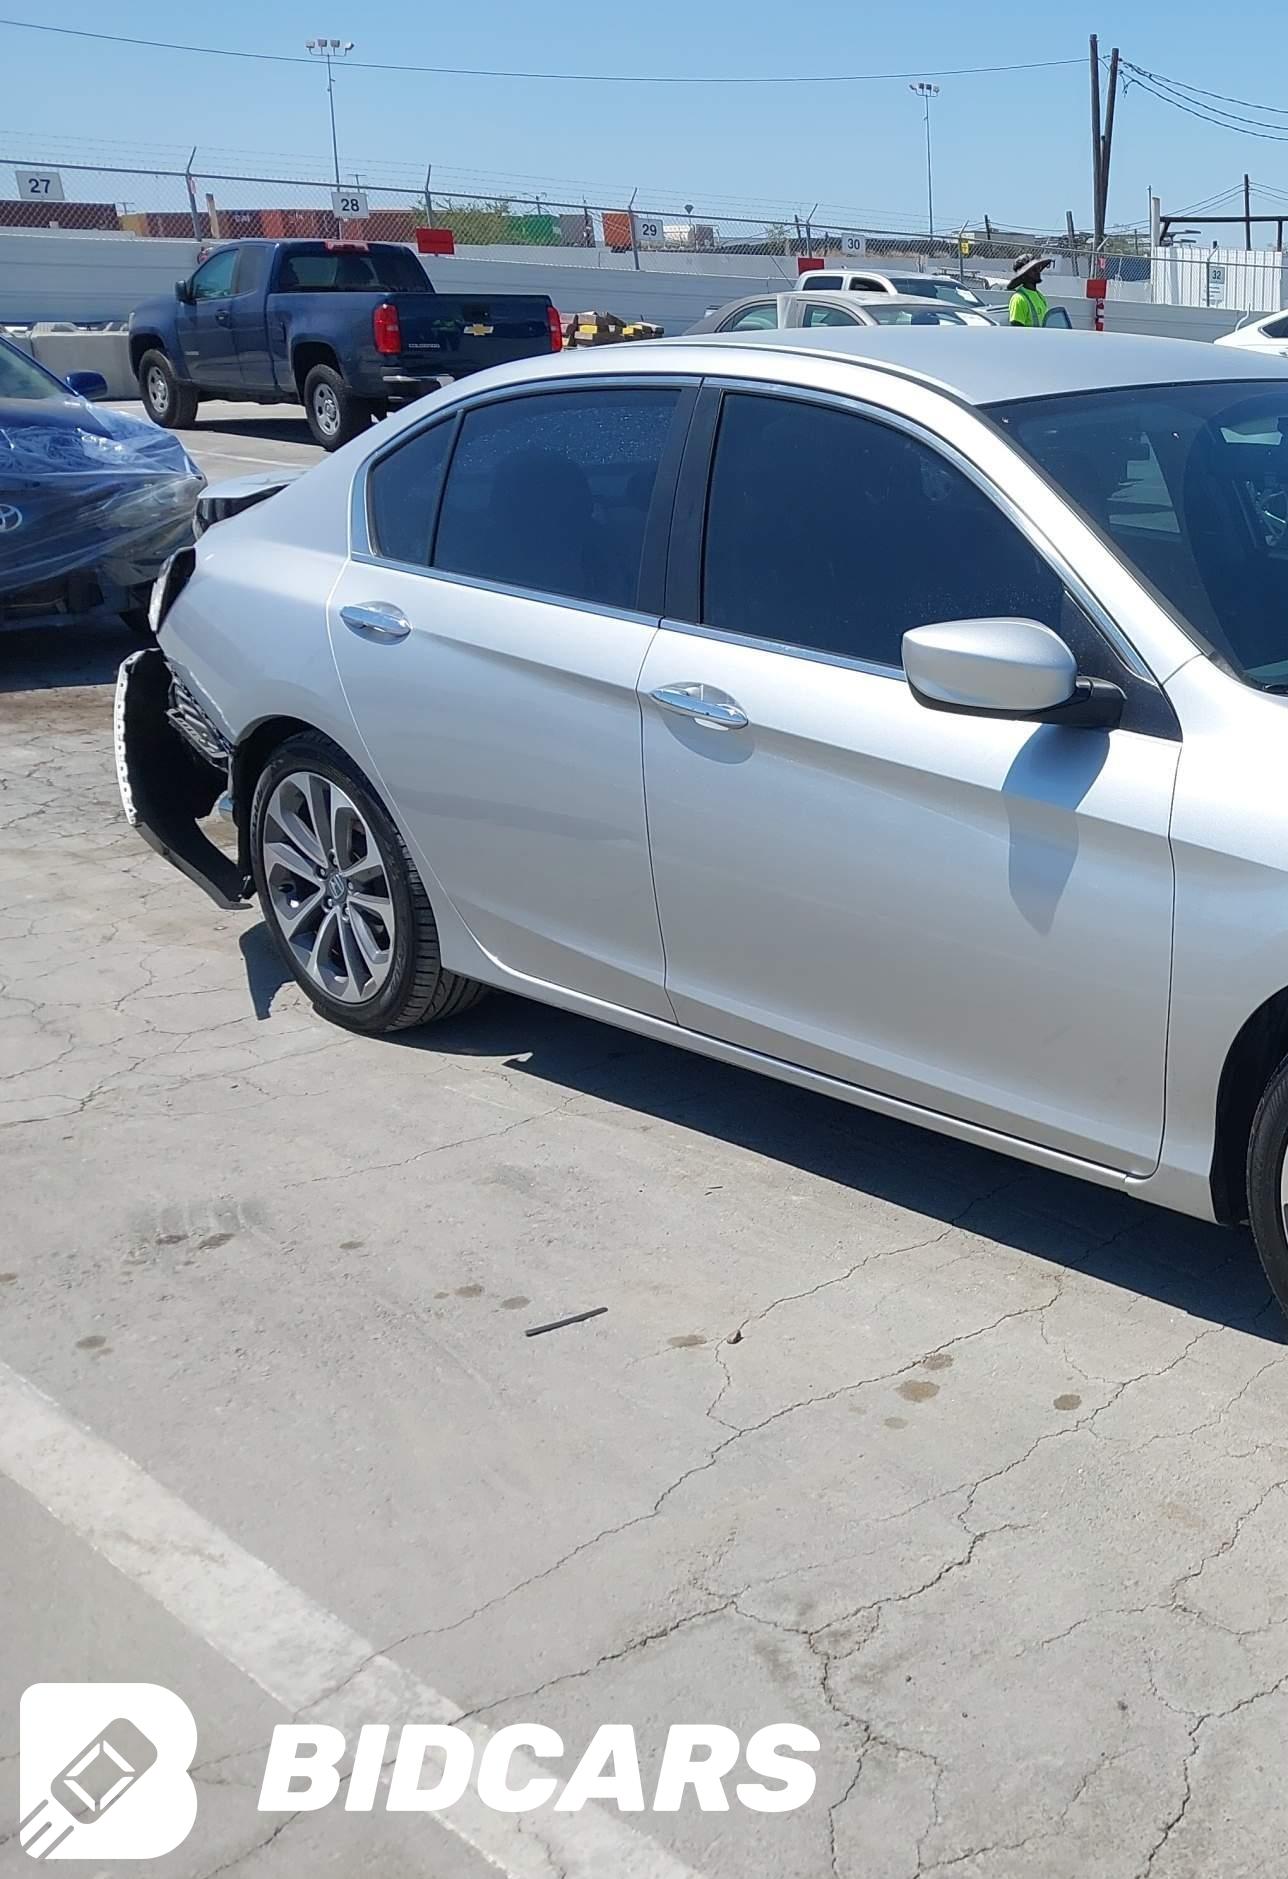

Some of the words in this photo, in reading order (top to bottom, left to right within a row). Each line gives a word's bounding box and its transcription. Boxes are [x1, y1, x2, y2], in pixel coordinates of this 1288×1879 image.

[28, 178, 51, 194] 27
[340, 198, 360, 212] 28
[642, 223, 658, 237] 29
[847, 238, 860, 250] 30
[1212, 269, 1222, 280] 32
